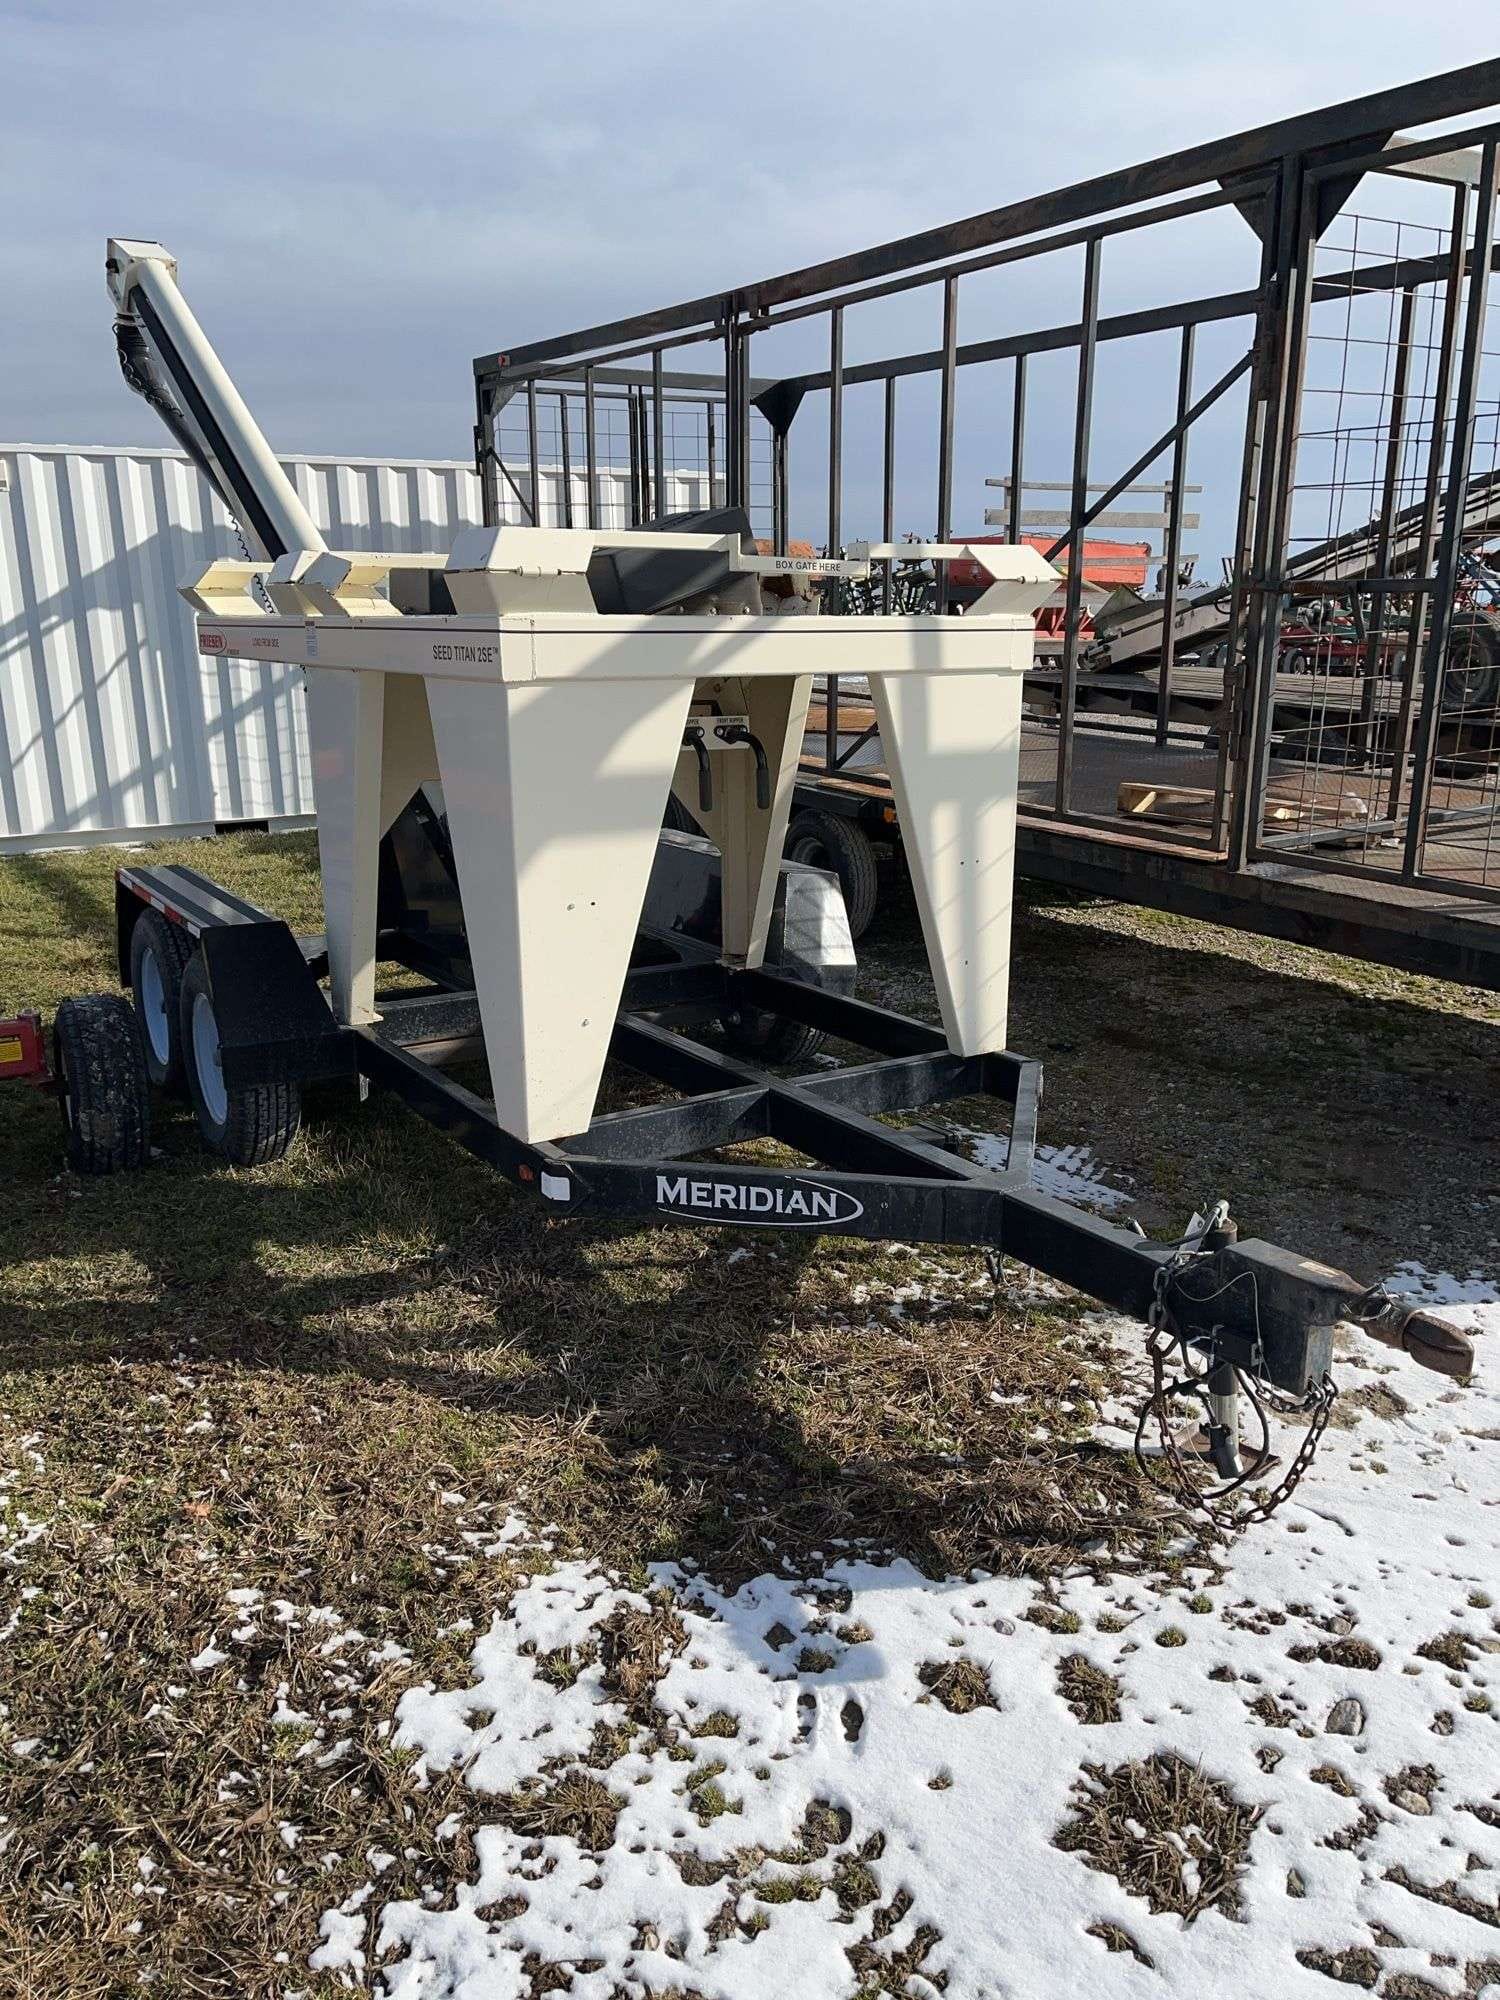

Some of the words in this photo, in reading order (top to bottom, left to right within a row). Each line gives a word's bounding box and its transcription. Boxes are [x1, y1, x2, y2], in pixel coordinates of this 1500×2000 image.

[776, 560, 793, 569] BOX
[795, 561, 817, 571] GATE
[819, 562, 841, 572] HERE
[199, 633, 223, 649] FRIESEN
[432, 644, 452, 660] SEED
[454, 645, 476, 662] TITAN
[656, 1175, 837, 1218] MERIDIAN
